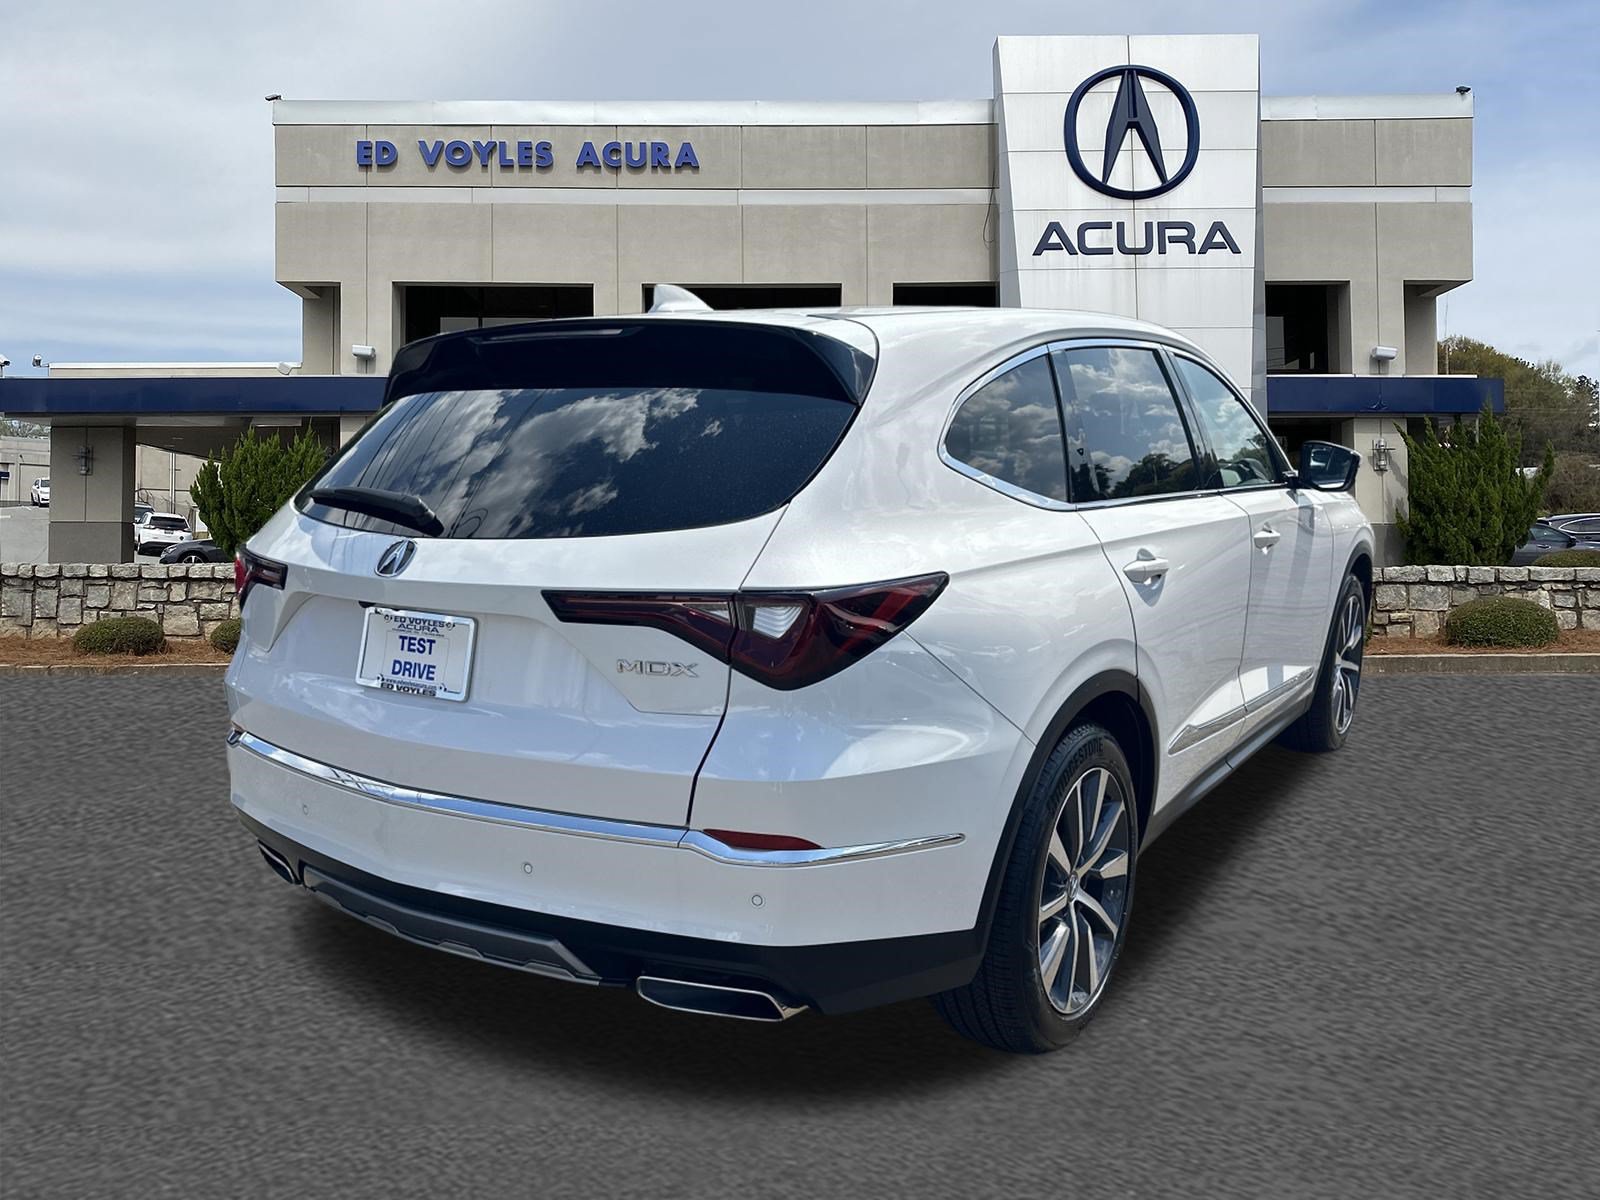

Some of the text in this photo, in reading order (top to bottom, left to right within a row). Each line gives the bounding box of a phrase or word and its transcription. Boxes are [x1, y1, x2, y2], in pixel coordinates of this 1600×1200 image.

[356, 139, 700, 168] ED VOYLES ACURA
[1032, 221, 1242, 256] ACURA
[393, 616, 445, 628] ED VOYLES
[397, 623, 439, 633] ACURA
[398, 635, 436, 655] TEST
[391, 659, 436, 681] DRIVE
[616, 659, 699, 678] MDX
[380, 682, 394, 691] ED
[395, 684, 437, 697] VOYLES
